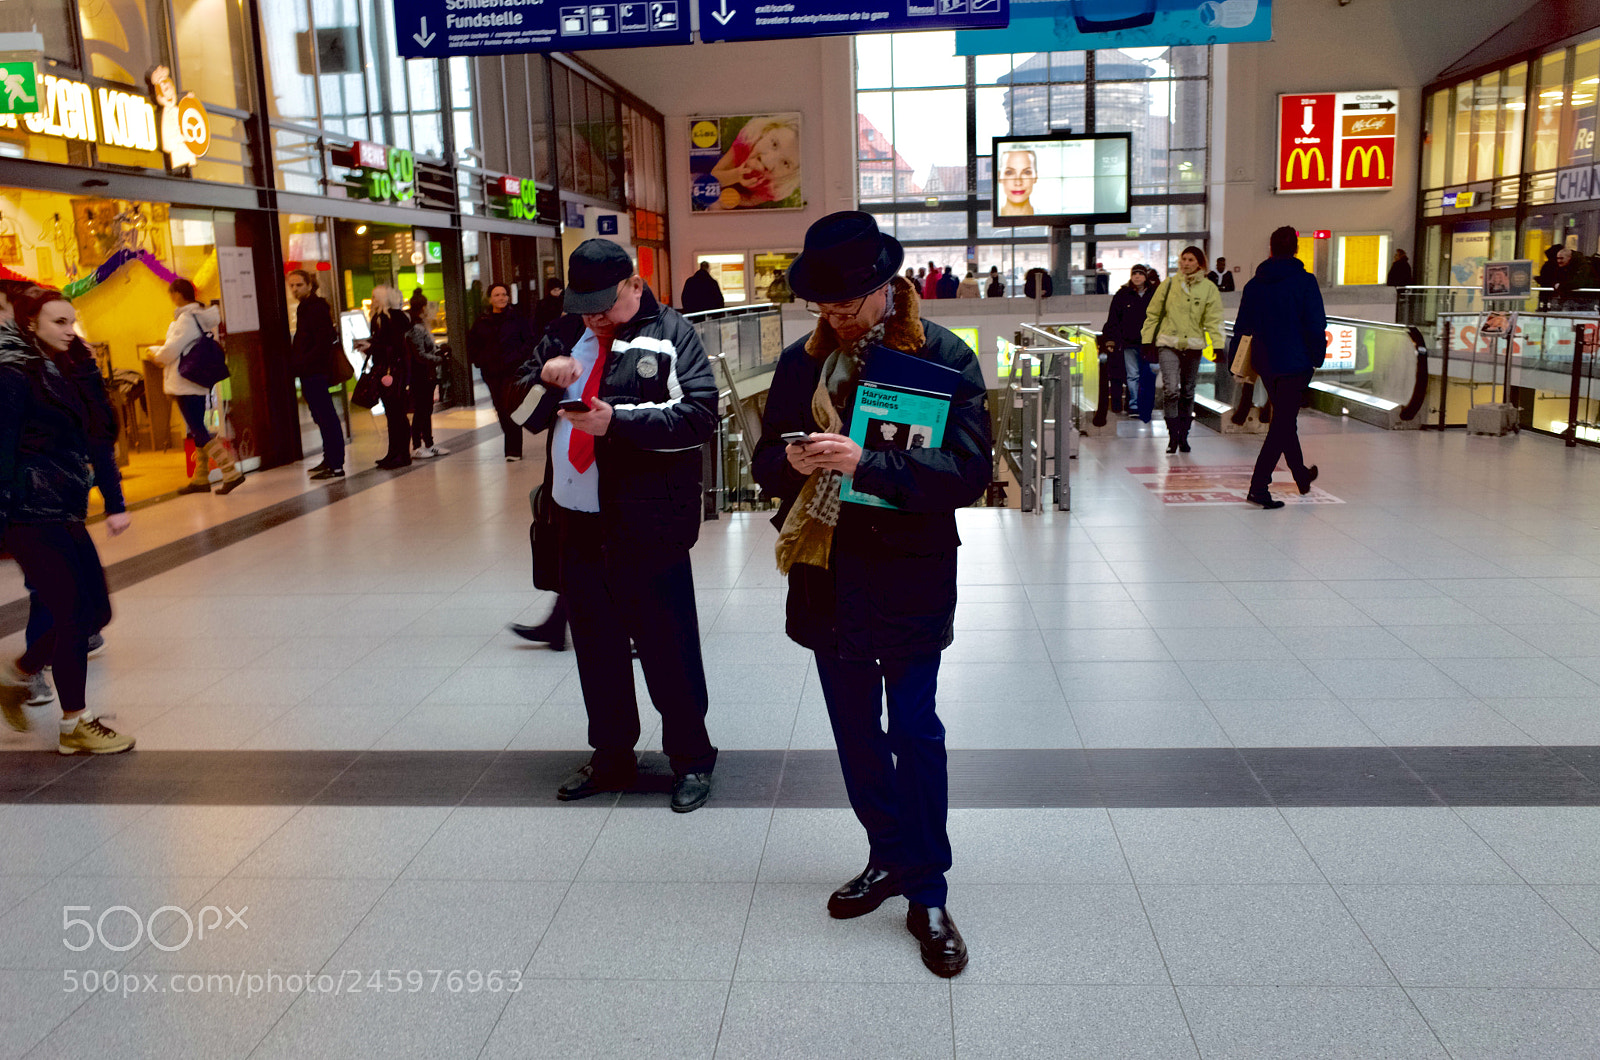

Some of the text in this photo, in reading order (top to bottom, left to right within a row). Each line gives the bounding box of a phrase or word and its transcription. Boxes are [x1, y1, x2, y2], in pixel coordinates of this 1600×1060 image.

[446, 11, 523, 28] Fundstelle
[389, 148, 414, 182] GO
[370, 172, 391, 199] TO
[521, 178, 536, 205] GO
[1339, 330, 1353, 359] UHR
[861, 397, 899, 410] Business
[862, 389, 898, 402] Harvard
